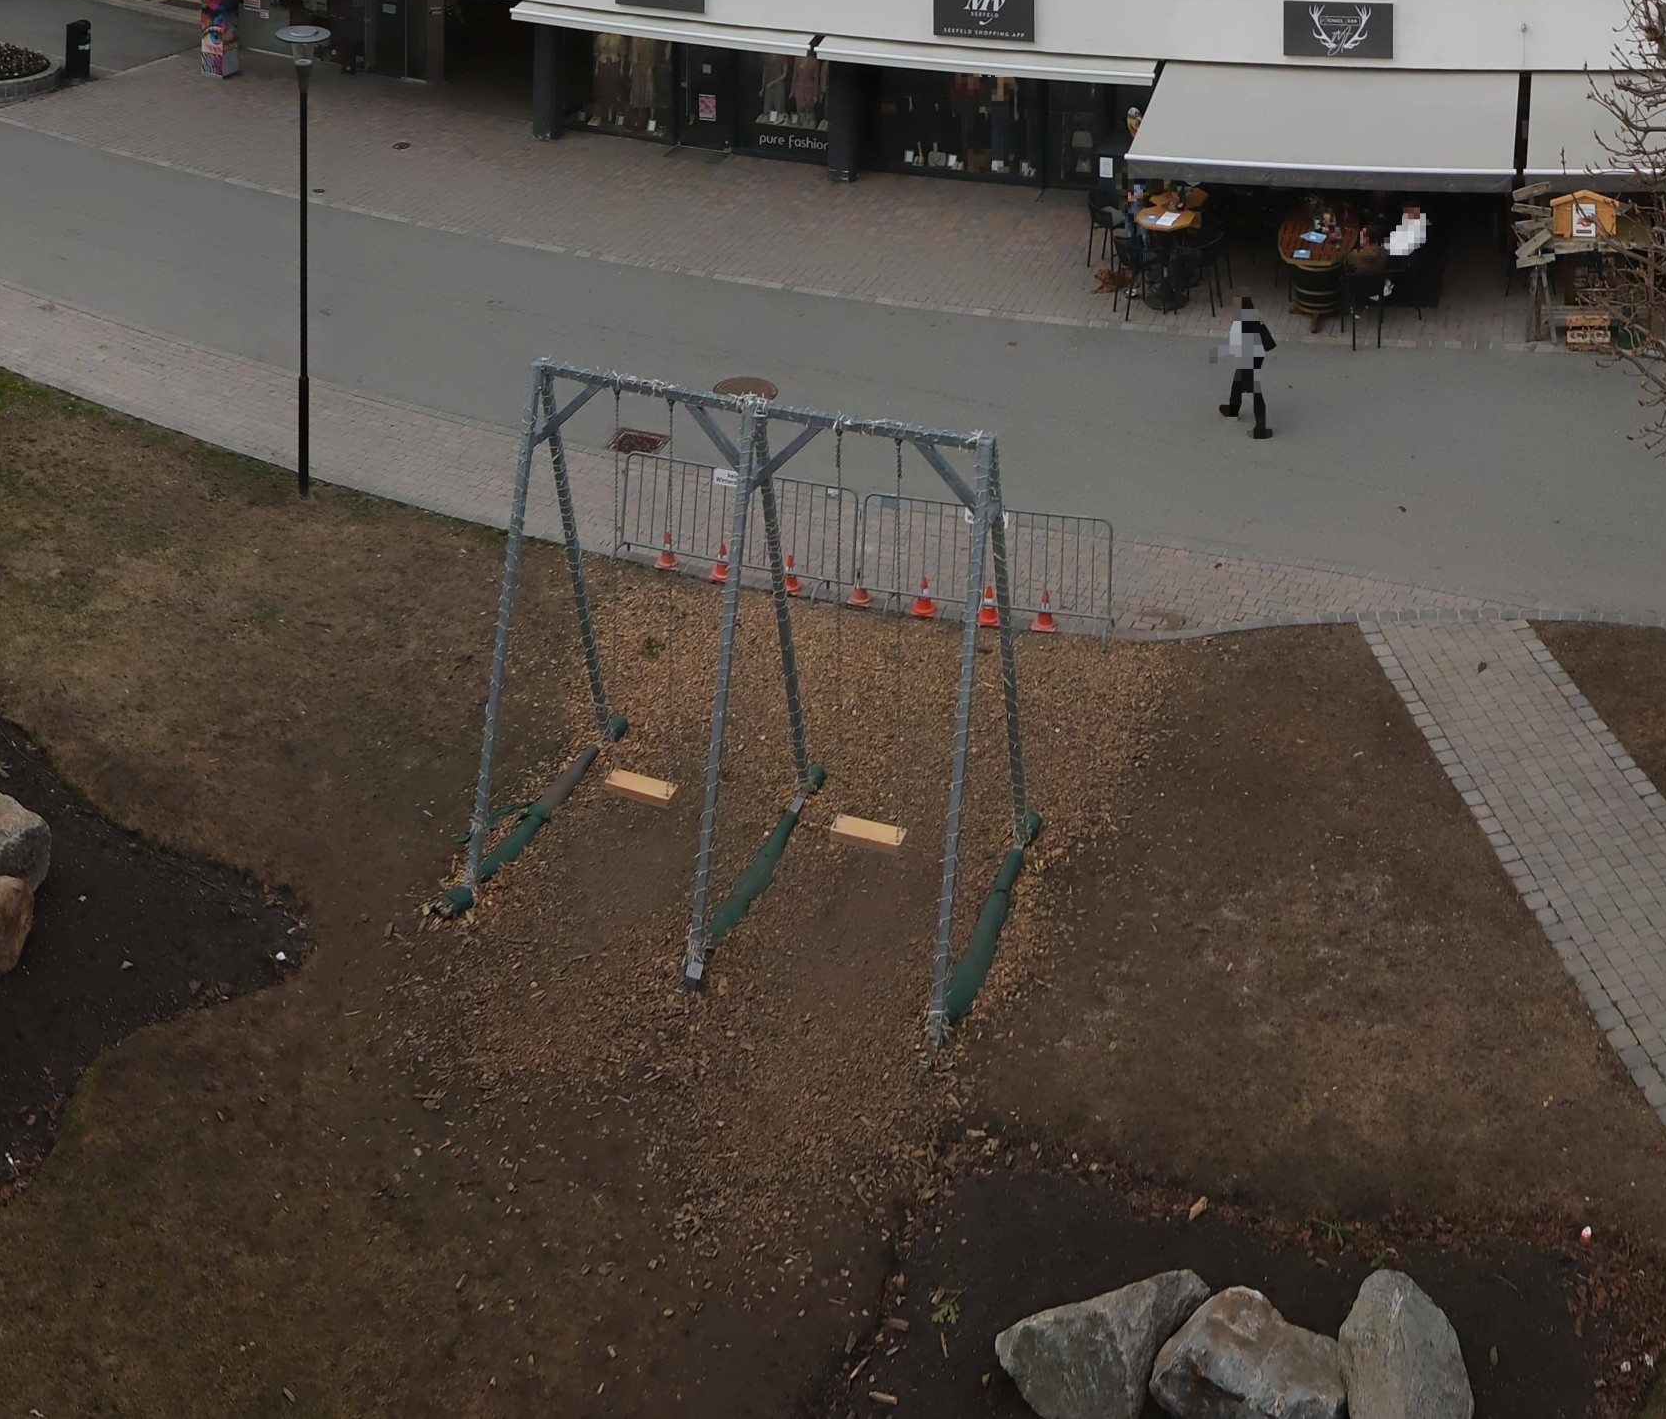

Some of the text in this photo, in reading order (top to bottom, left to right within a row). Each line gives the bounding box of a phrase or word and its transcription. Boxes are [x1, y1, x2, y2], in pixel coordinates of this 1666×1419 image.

[943, 27, 972, 35] SEEFELD
[974, 29, 1010, 37] SHOPPING
[759, 134, 784, 146] pure
